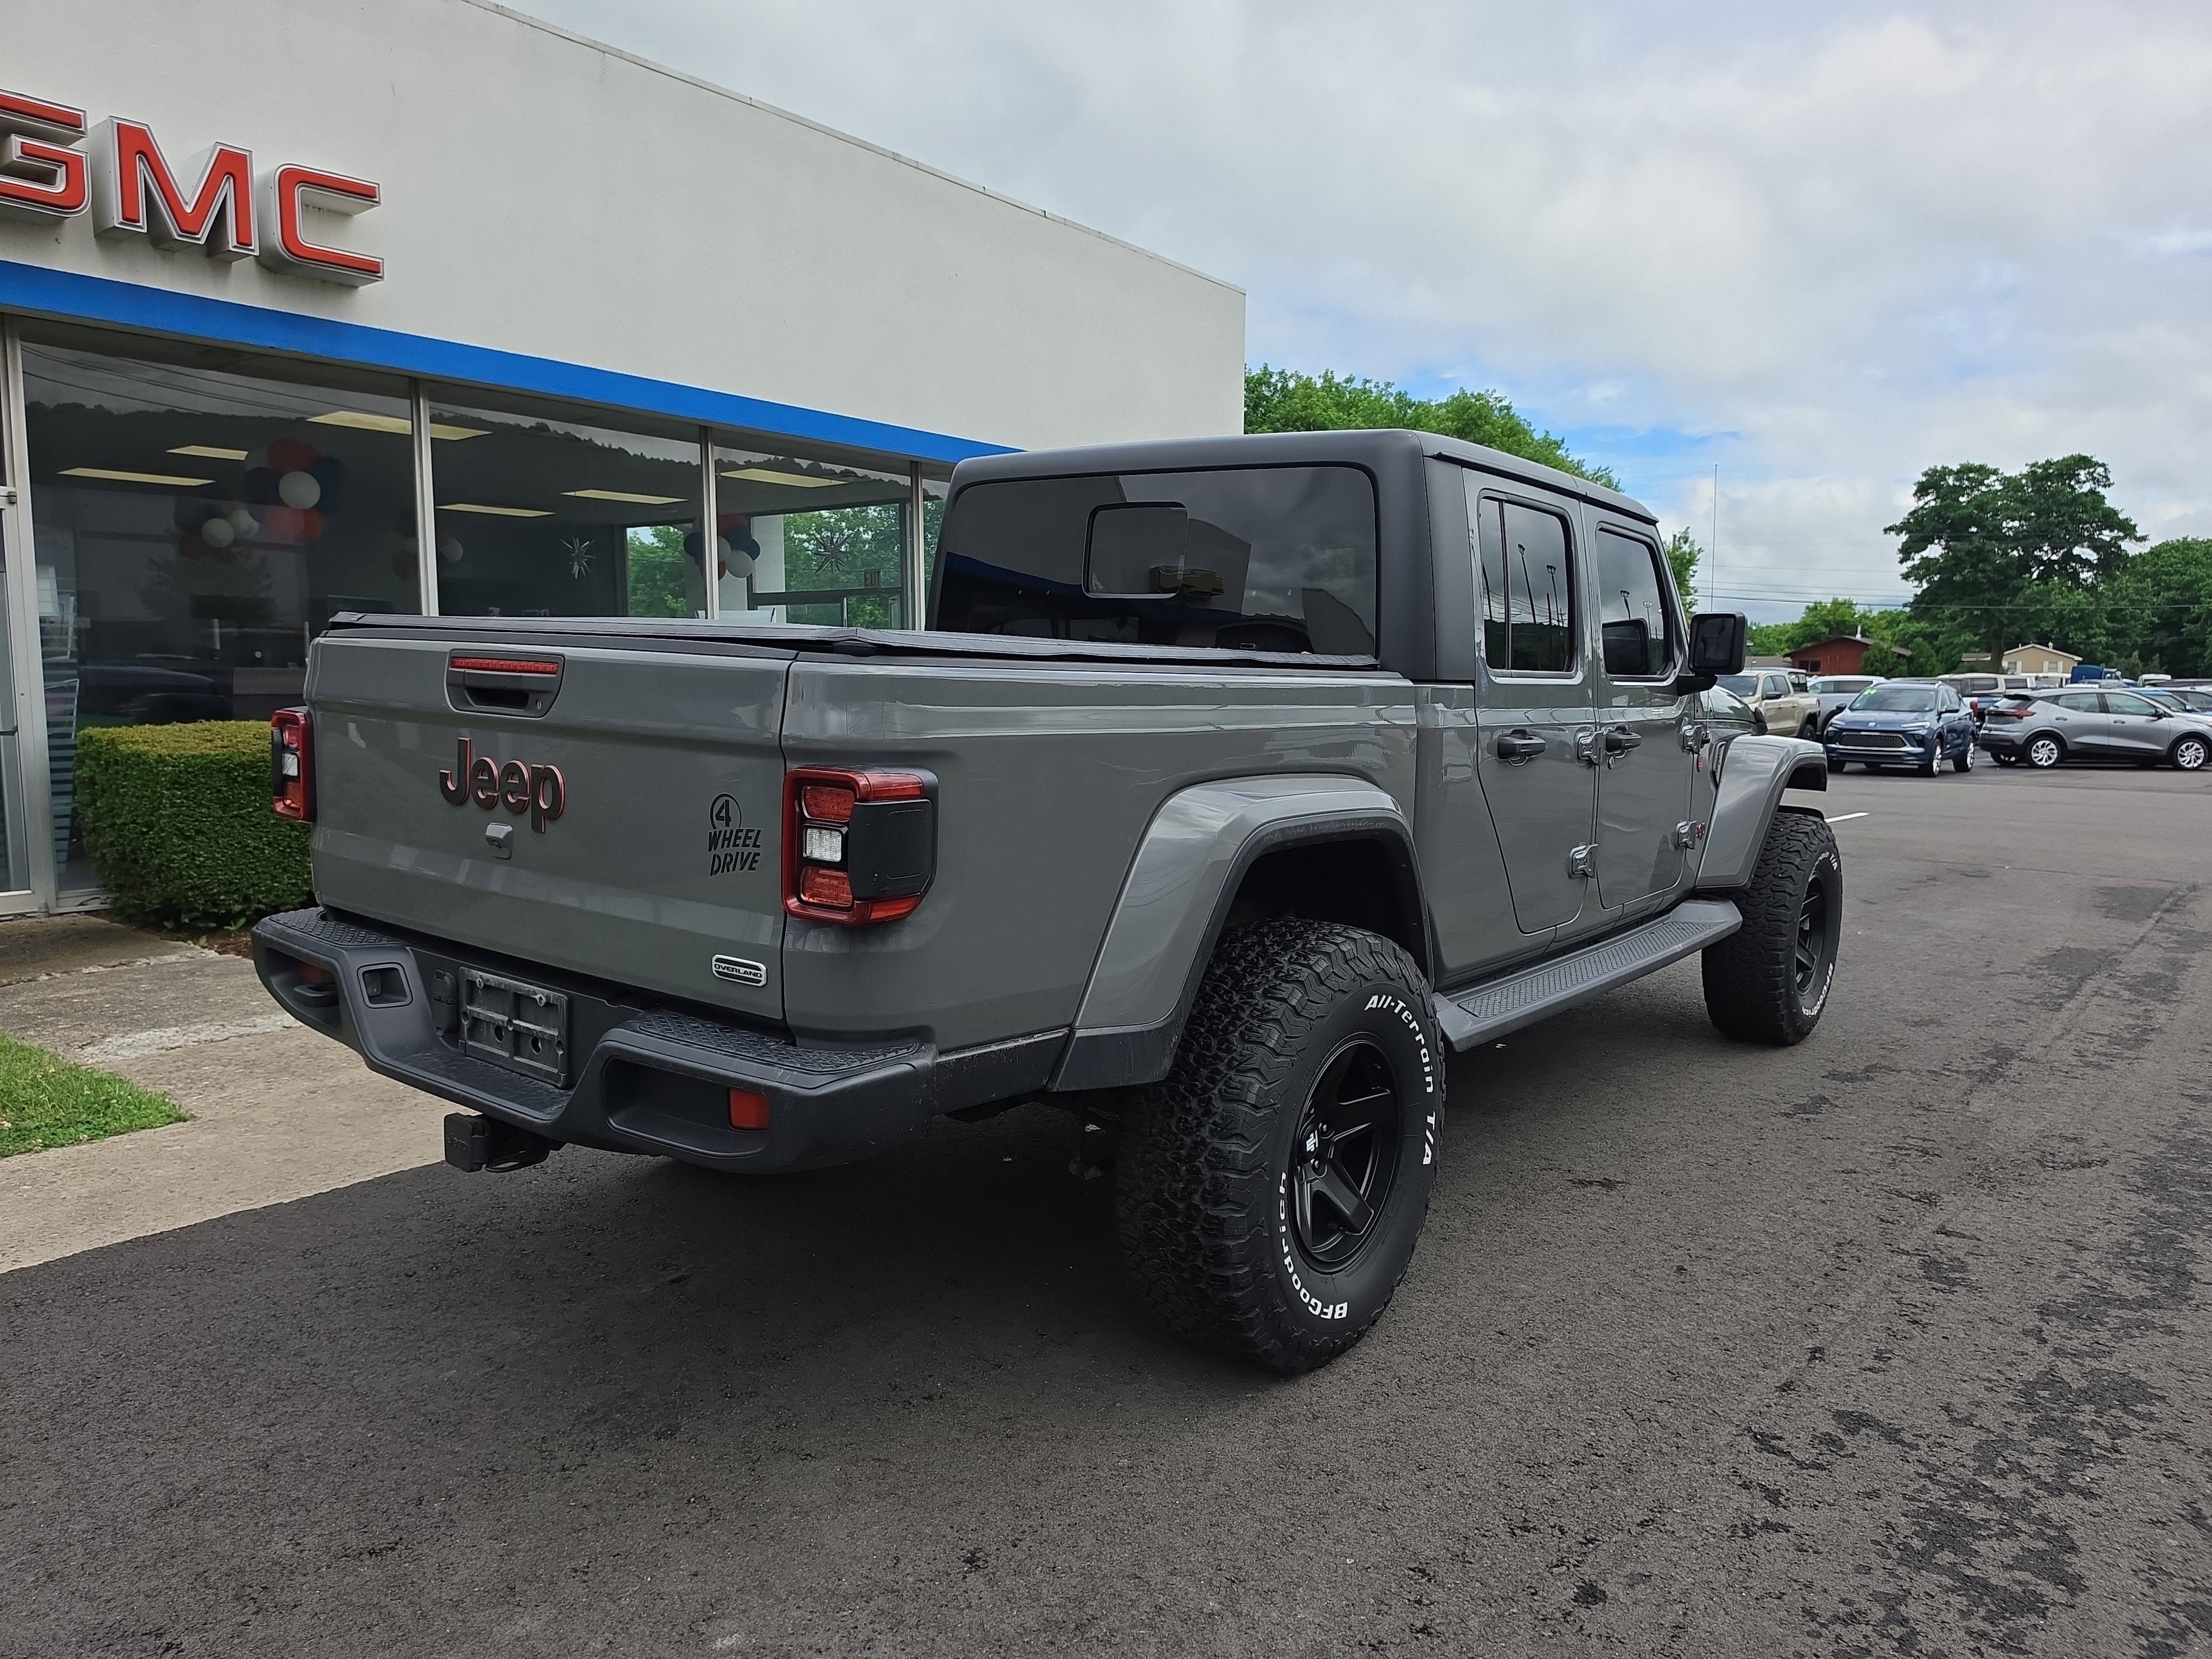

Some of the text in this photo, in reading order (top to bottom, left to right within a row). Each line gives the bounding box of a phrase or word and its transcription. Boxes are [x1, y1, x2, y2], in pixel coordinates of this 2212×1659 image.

[0, 89, 385, 281] GMC
[439, 737, 565, 833] Jeep
[708, 828, 762, 852] WHEEL
[715, 800, 732, 827] 4
[709, 852, 761, 876] DRIVE
[714, 963, 762, 979] OVERLAND
[1802, 962, 1834, 1018] BFGoodrich
[1364, 994, 1436, 1165] All-Terrain T/A
[1278, 1172, 1348, 1320] BFGoodrich
